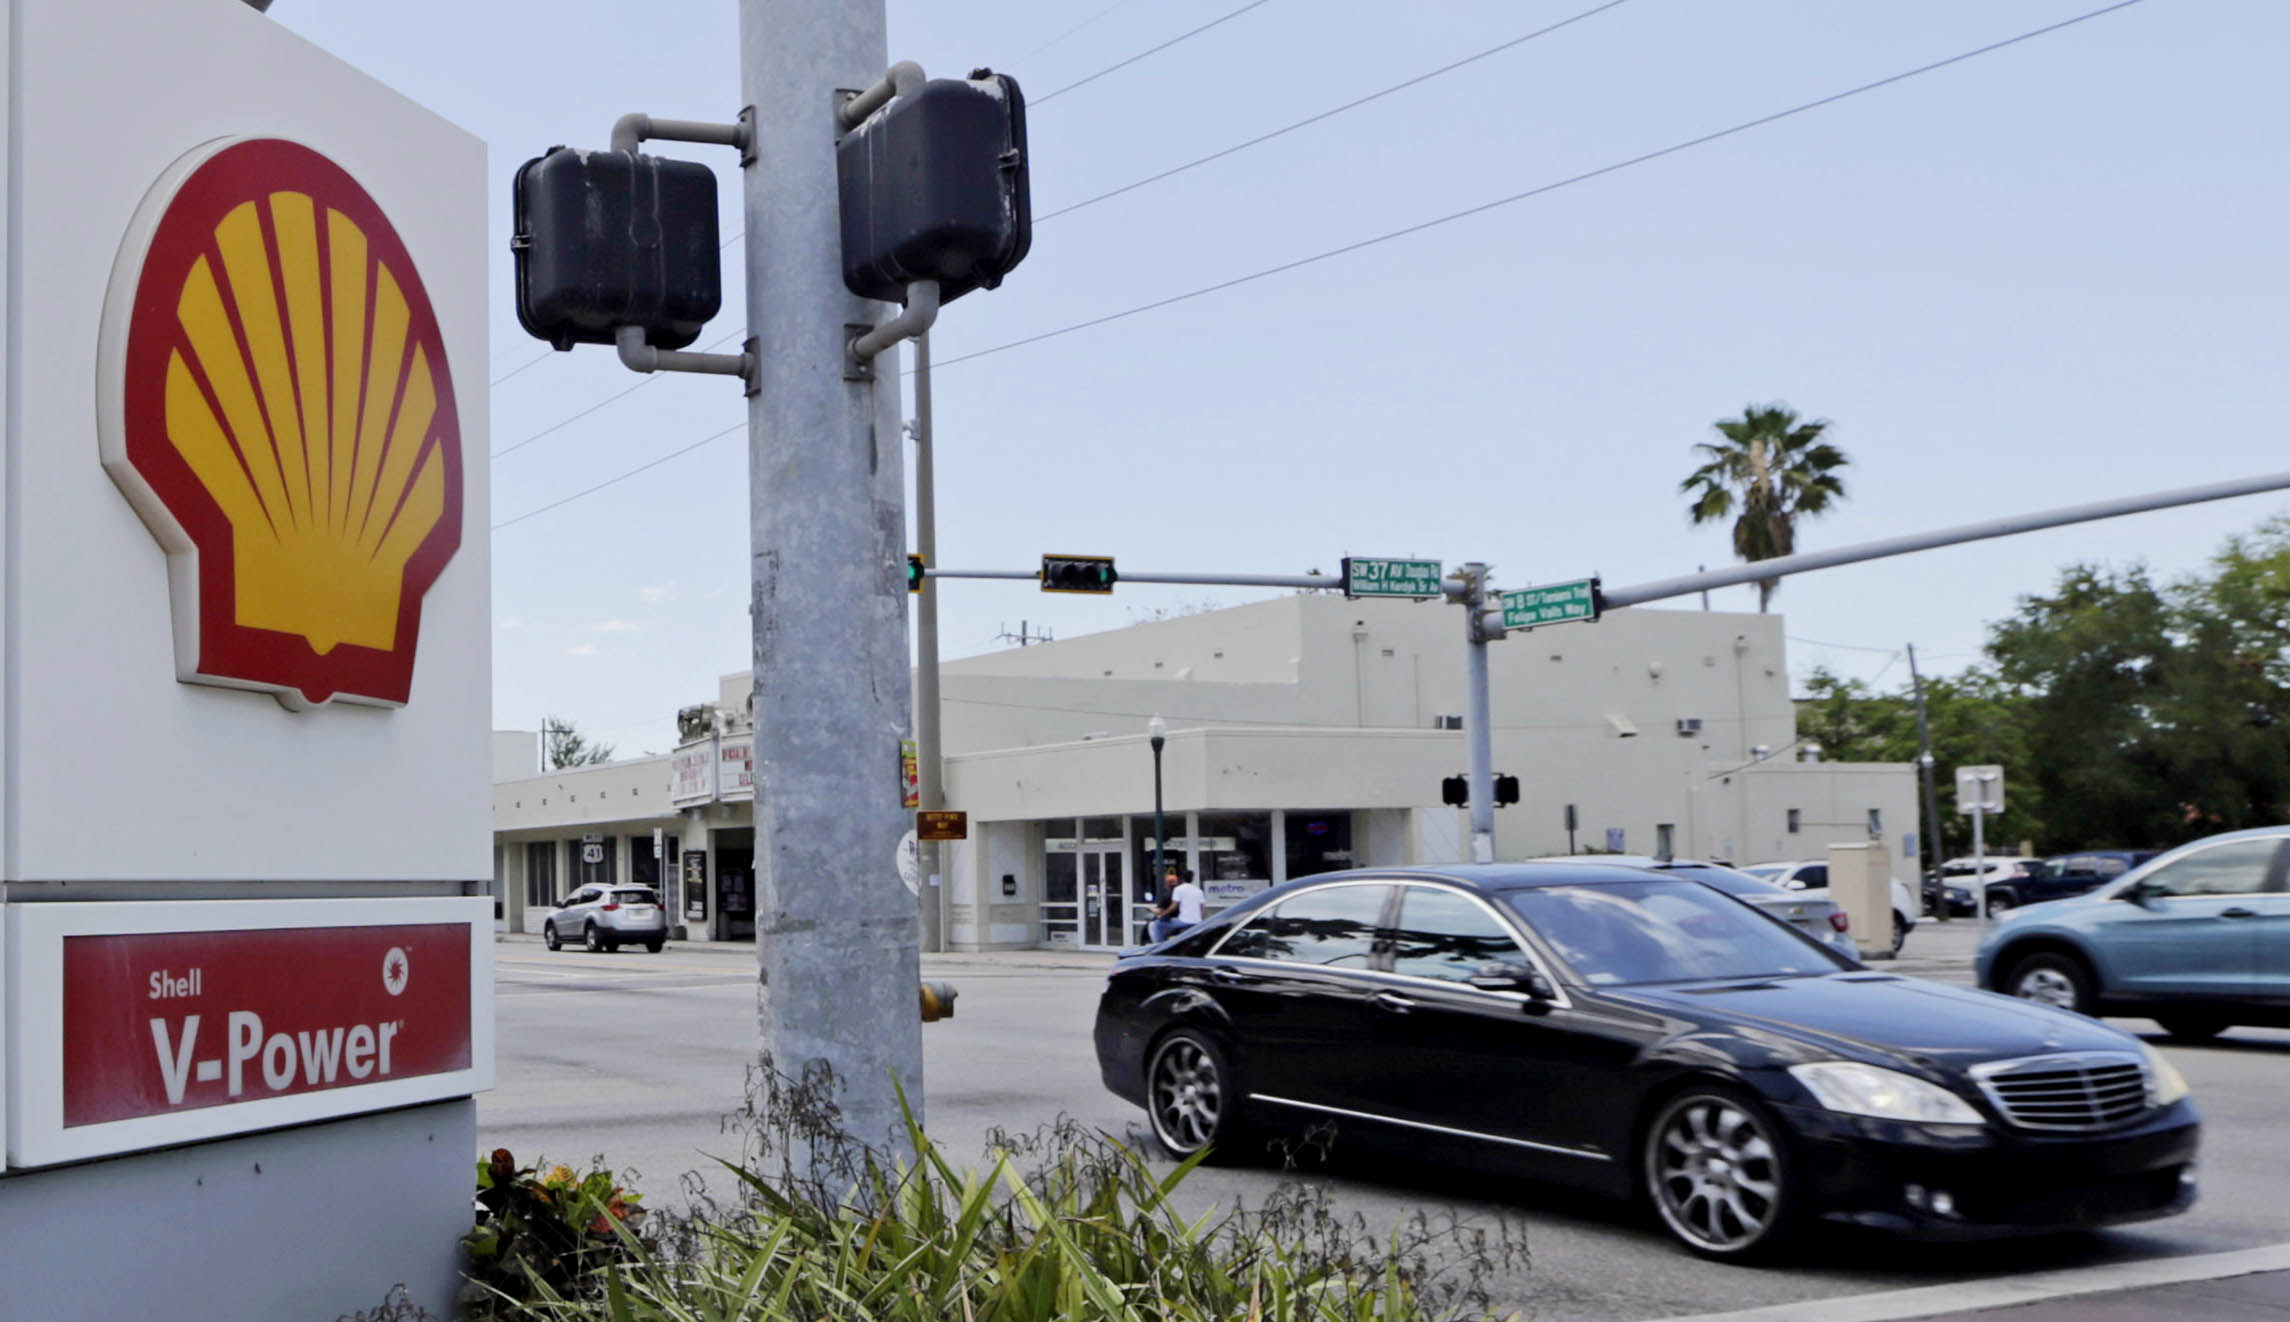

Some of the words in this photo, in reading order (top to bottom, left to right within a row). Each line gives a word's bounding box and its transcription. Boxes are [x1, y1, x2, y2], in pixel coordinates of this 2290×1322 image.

[1352, 562, 1368, 577] SW
[1368, 561, 1388, 580] 37
[1390, 563, 1403, 578] AV
[587, 847, 601, 859] 41
[1208, 882, 1245, 893] metro
[149, 967, 202, 1000] Shell
[149, 1010, 399, 1105] V-Power
